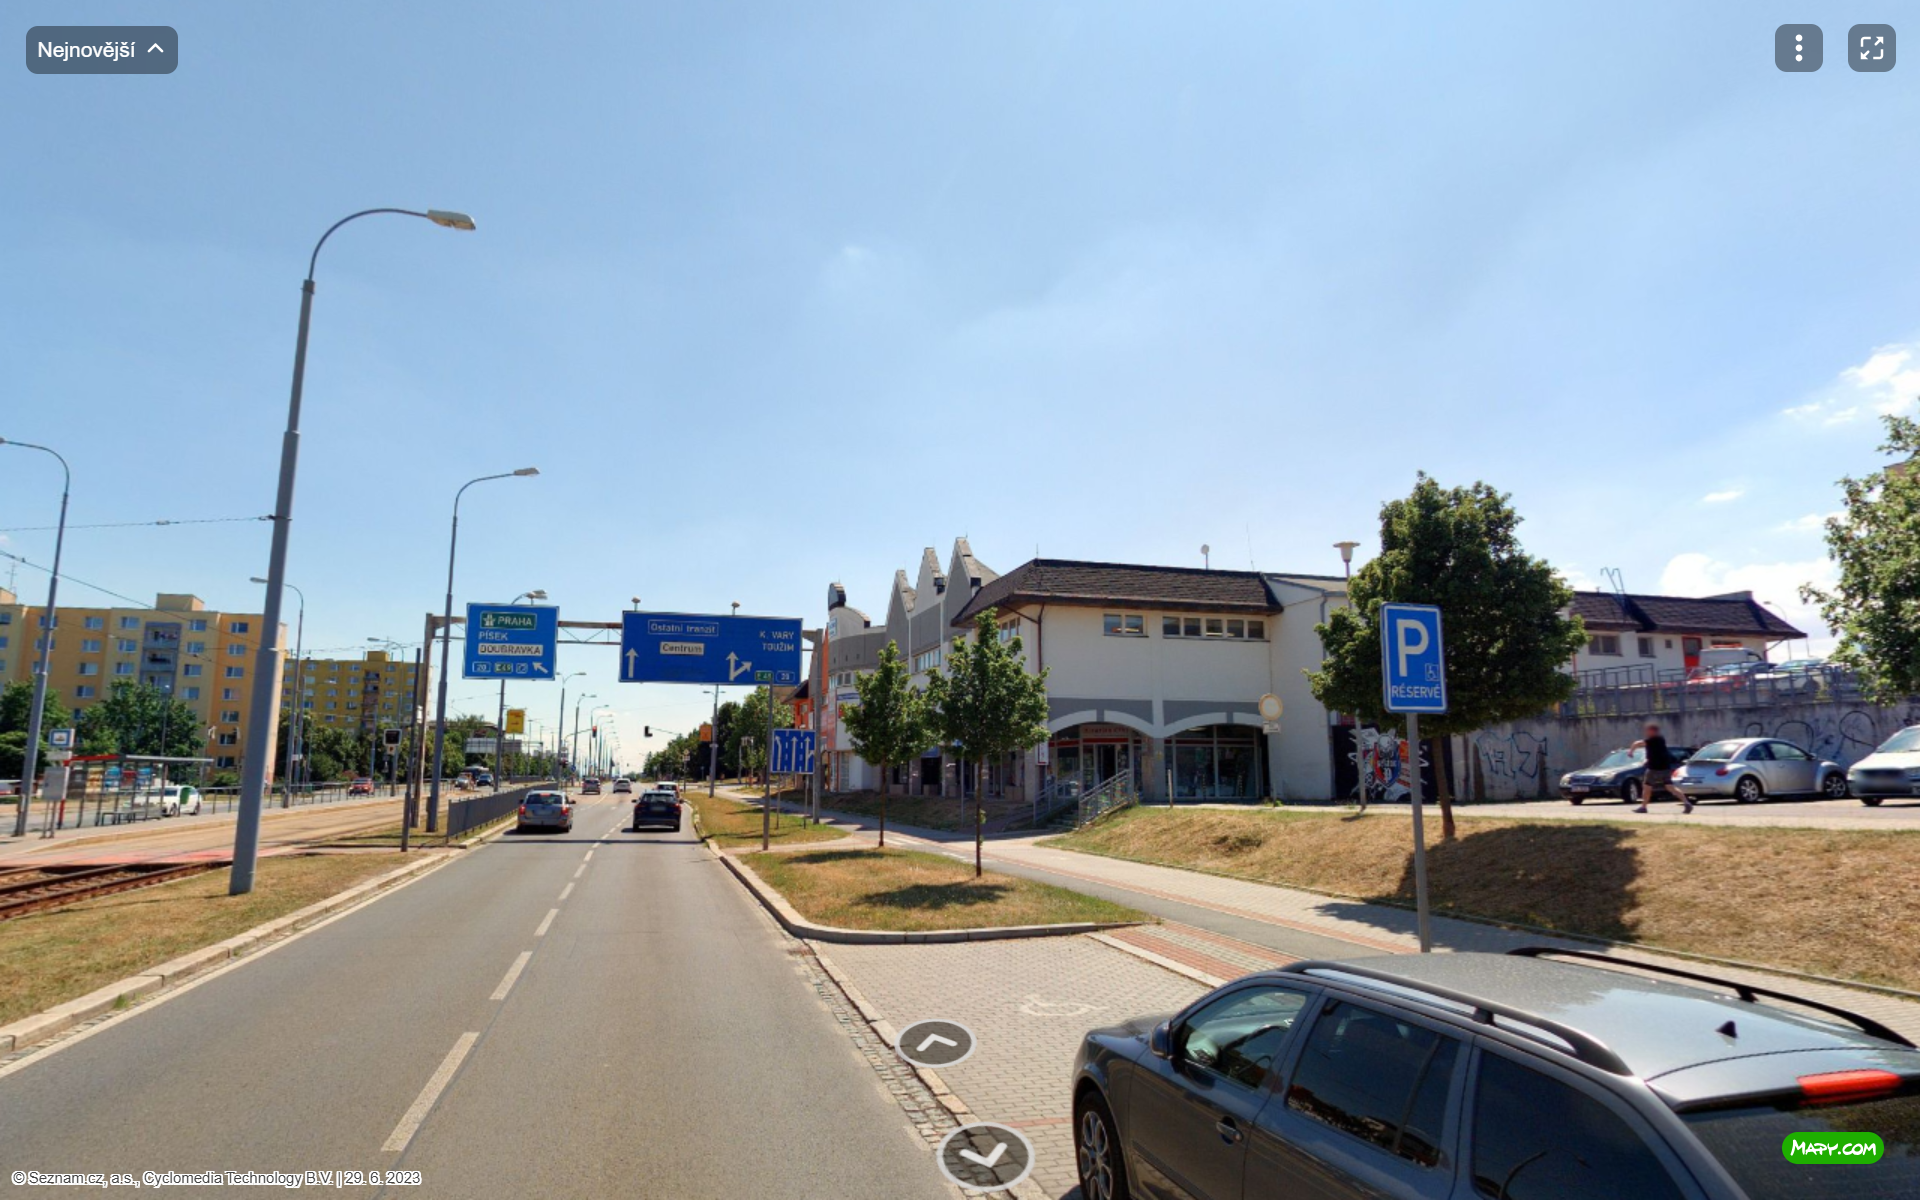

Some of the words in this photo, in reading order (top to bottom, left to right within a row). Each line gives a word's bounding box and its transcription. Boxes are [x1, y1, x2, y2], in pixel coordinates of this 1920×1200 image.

[497, 616, 533, 626] PRAHA
[686, 625, 716, 634] tranzit
[478, 630, 508, 641] PÍSEK
[772, 631, 794, 640] VARY
[480, 645, 541, 655] DOUBRAVKA
[662, 643, 702, 653] Centrum
[762, 641, 794, 652] TOUŽIM
[1396, 619, 1429, 677] P
[1391, 683, 1441, 698] RÉSERVÉ
